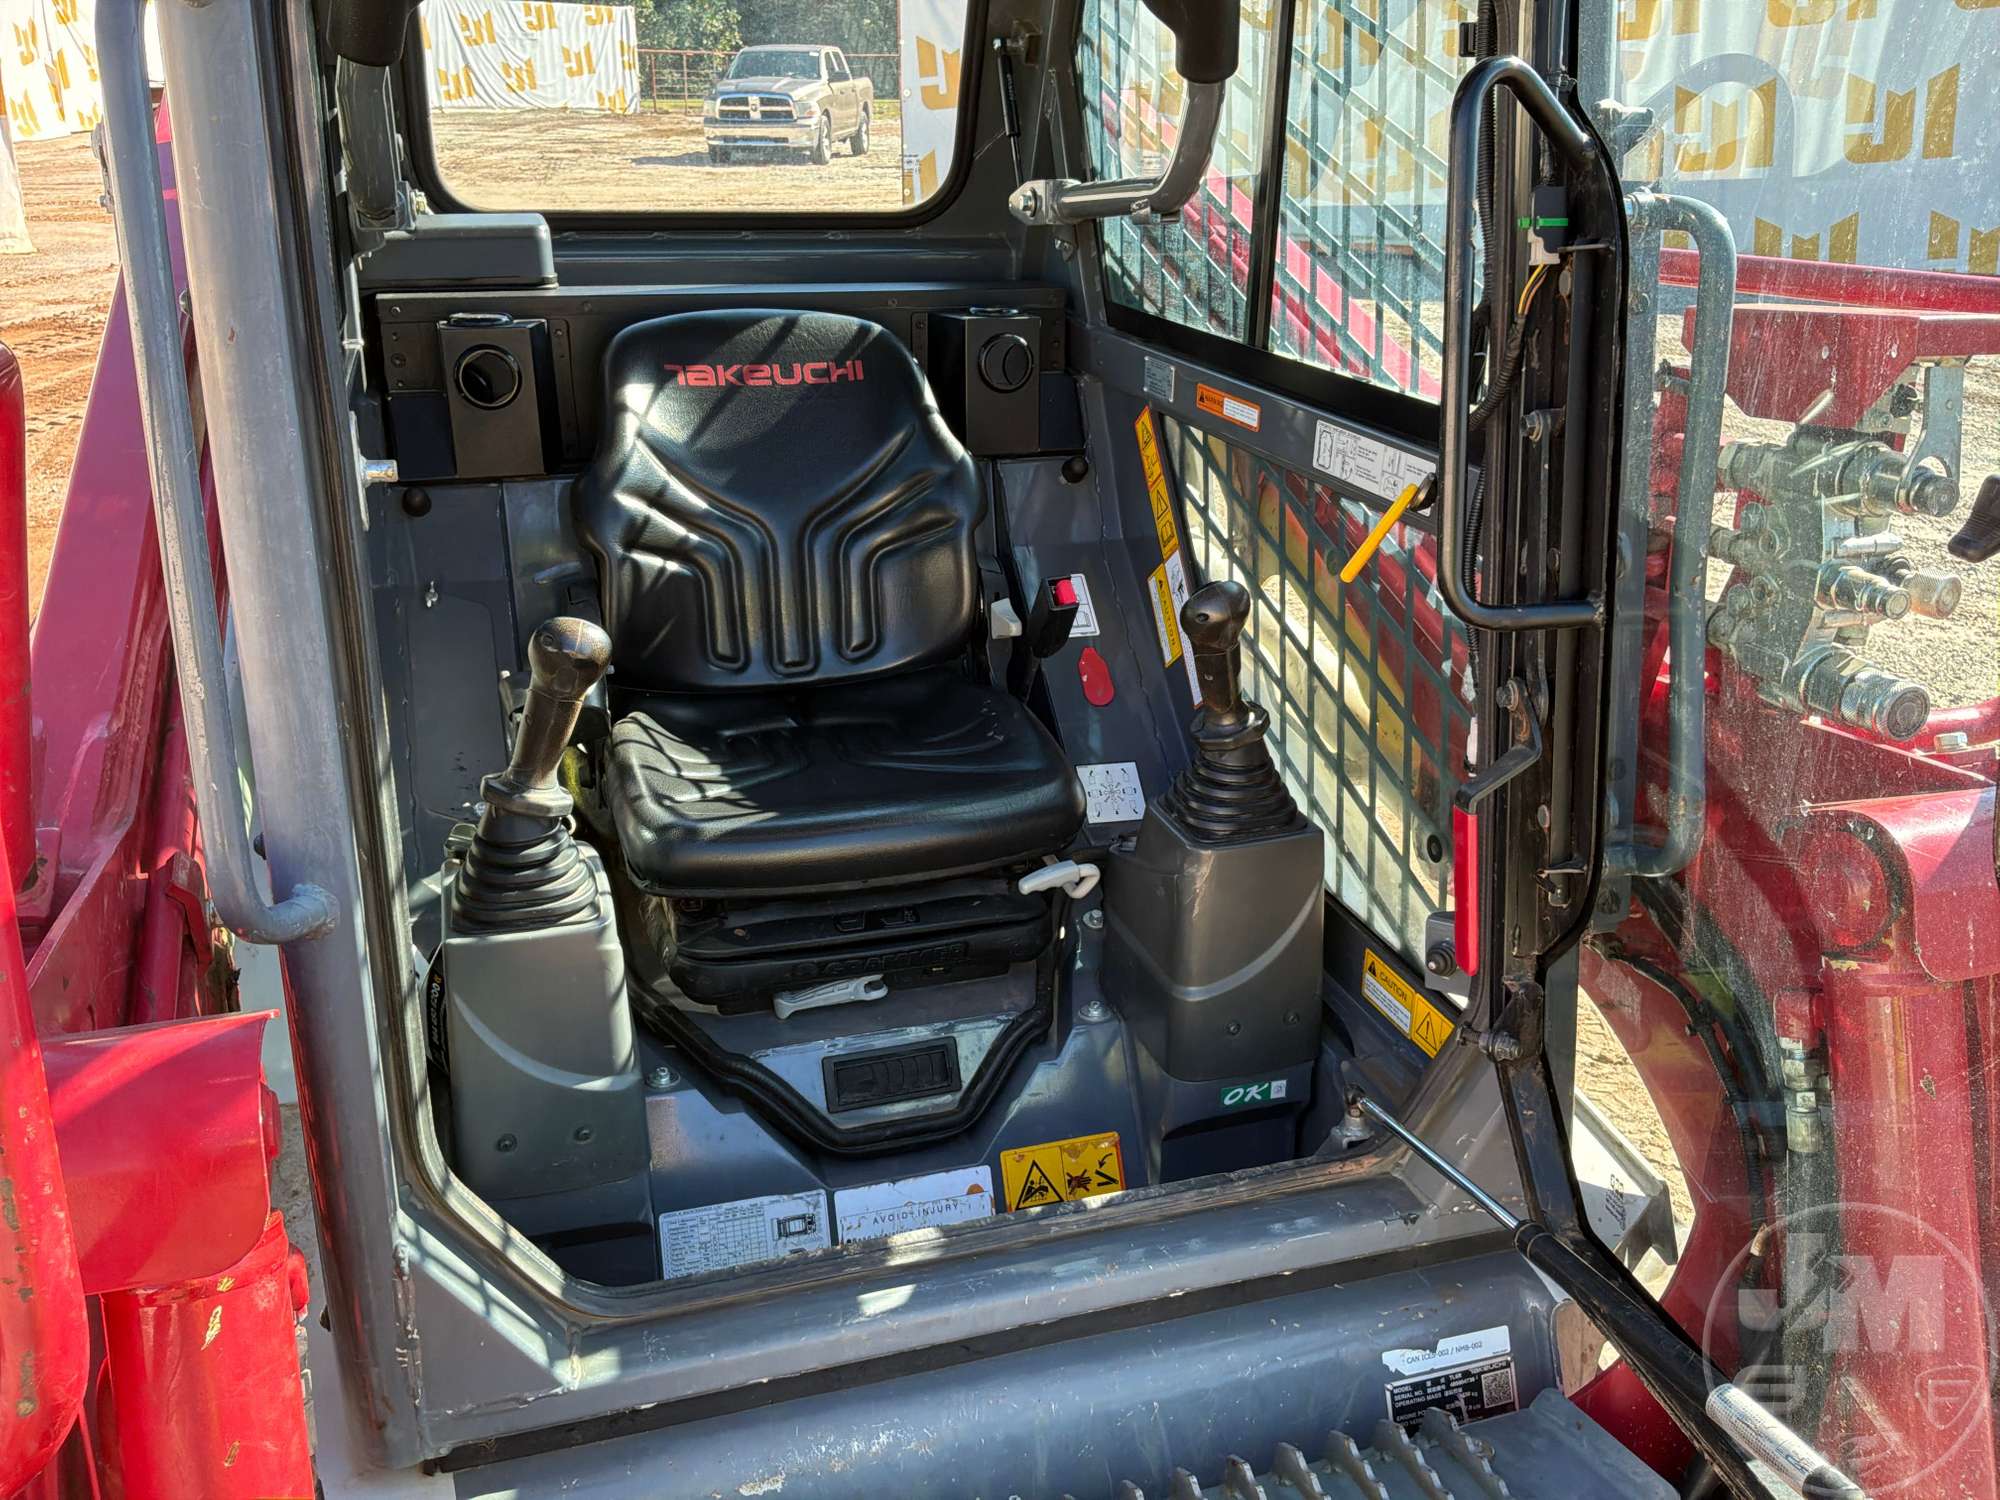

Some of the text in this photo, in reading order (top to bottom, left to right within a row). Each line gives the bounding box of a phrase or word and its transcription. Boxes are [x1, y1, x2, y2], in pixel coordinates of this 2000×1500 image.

[664, 359, 864, 387] TAKEUCHI
[1379, 971, 1408, 1001] CAUTION
[1223, 1082, 1269, 1106] OK
[872, 1203, 960, 1226] AVOID INJURY
[1406, 1354, 1420, 1364] CAN
[1393, 1385, 1412, 1394] MODEL
[1394, 1392, 1414, 1402] SERIAL
[1395, 1392, 1442, 1408] OPERATING MASS
